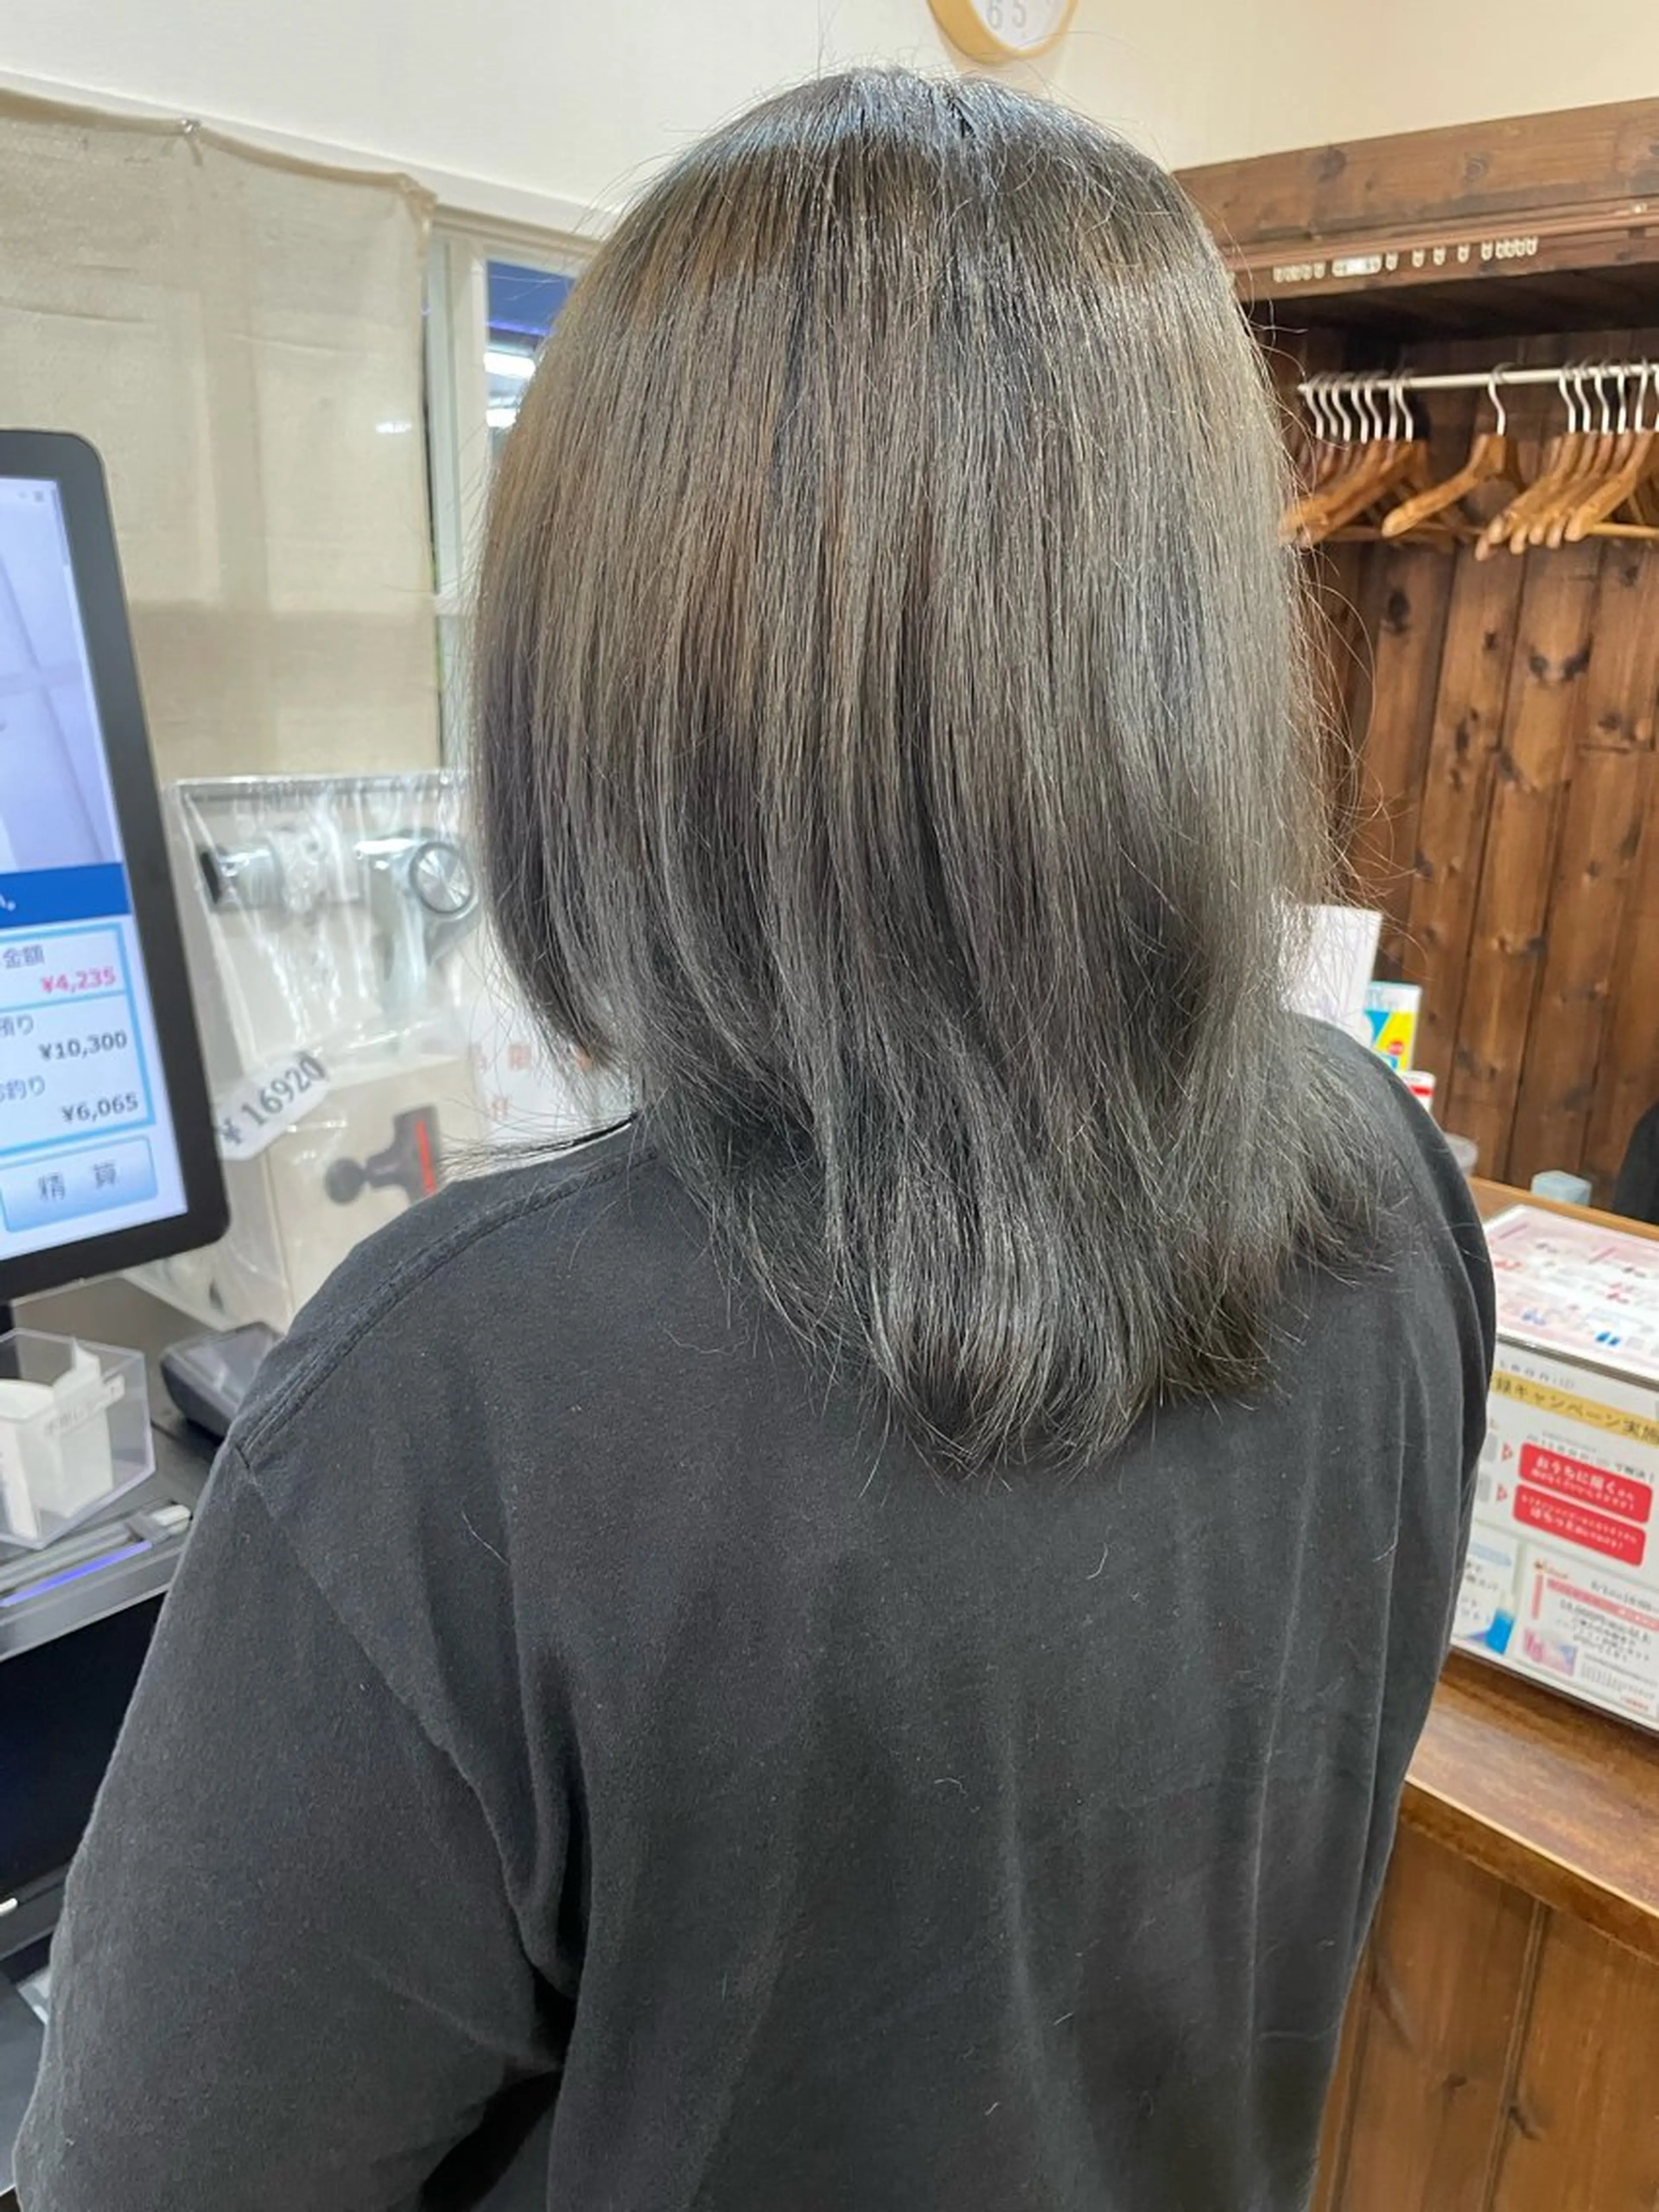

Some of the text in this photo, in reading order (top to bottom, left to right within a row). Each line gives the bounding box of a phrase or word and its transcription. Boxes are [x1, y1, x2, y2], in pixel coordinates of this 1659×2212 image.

[41, 965, 116, 993] ¥4,235
[39, 1030, 128, 1061] ¥10,300
[0, 1075, 45, 1101] 釣り
[60, 1091, 139, 1124] ¥6,065
